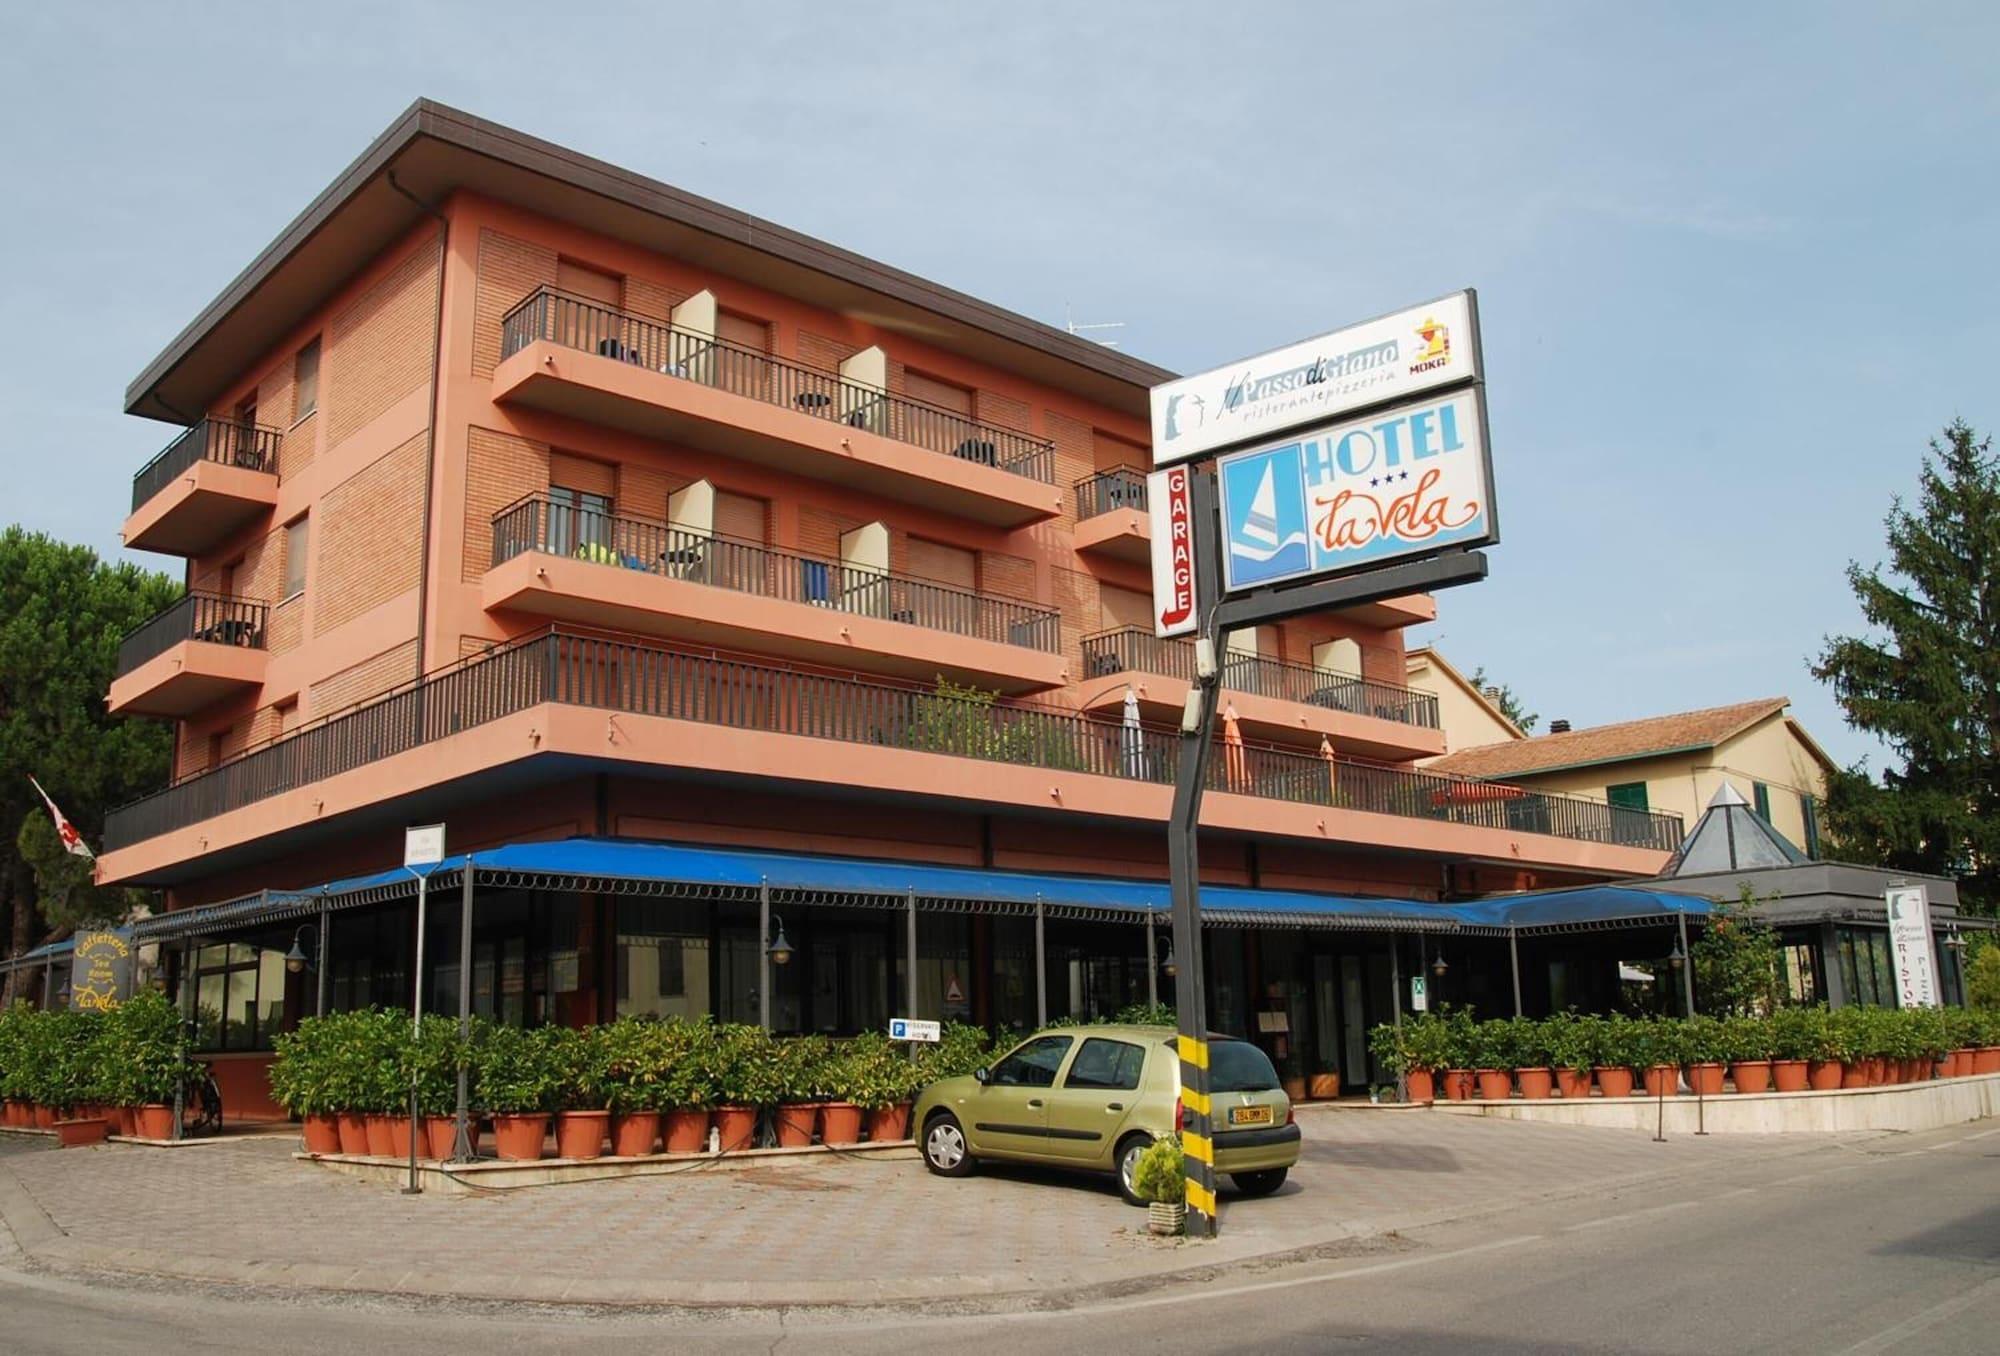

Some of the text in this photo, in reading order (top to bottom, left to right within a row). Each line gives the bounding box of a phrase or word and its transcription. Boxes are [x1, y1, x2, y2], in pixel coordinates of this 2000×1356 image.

[1306, 356, 1327, 386] di
[1304, 404, 1464, 487] HOTEL
[1169, 474, 1190, 611] GARAGE
